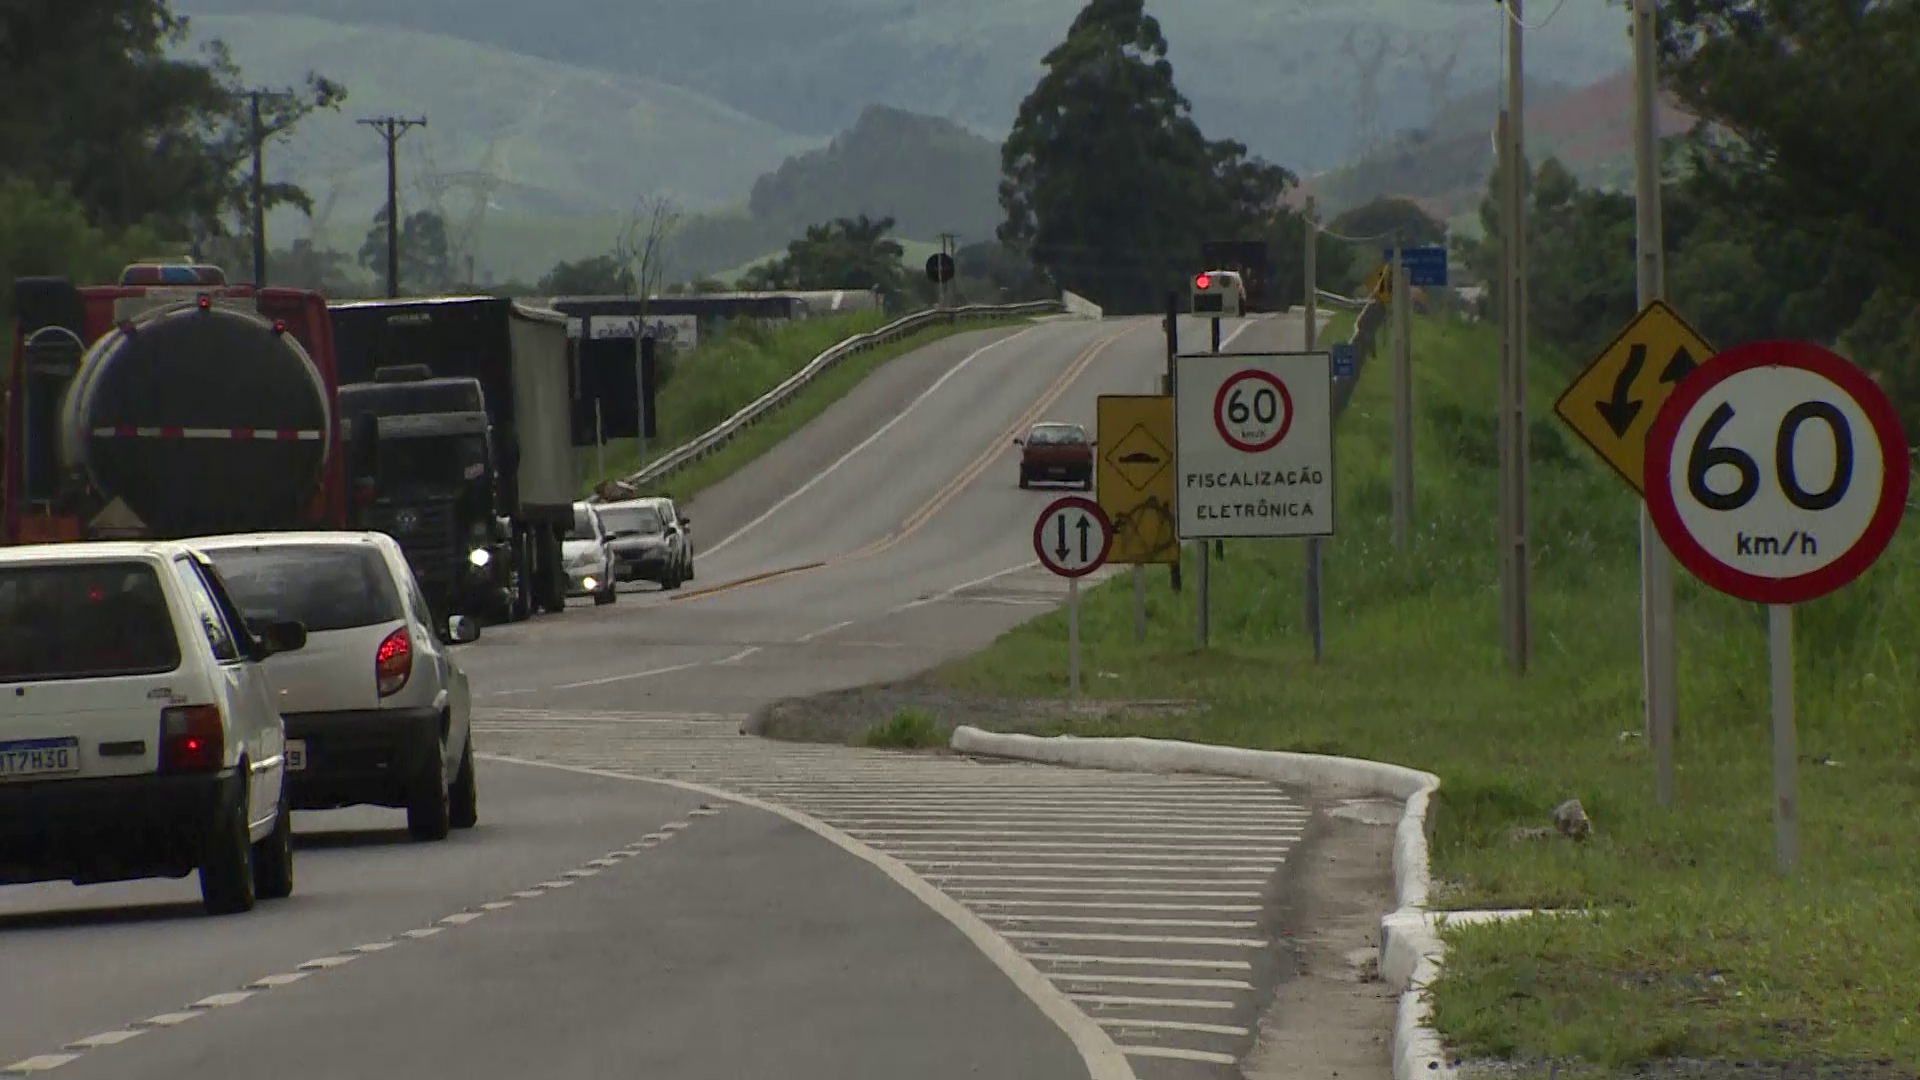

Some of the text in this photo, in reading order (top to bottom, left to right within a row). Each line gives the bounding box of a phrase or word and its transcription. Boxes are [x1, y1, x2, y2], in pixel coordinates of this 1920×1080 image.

[1228, 388, 1277, 424] 60
[1688, 401, 1854, 511] 60
[1187, 467, 1323, 488] FISCALIZAÇÃO
[1197, 498, 1314, 520] ELETRÔNICA
[1737, 531, 1817, 556] km/h
